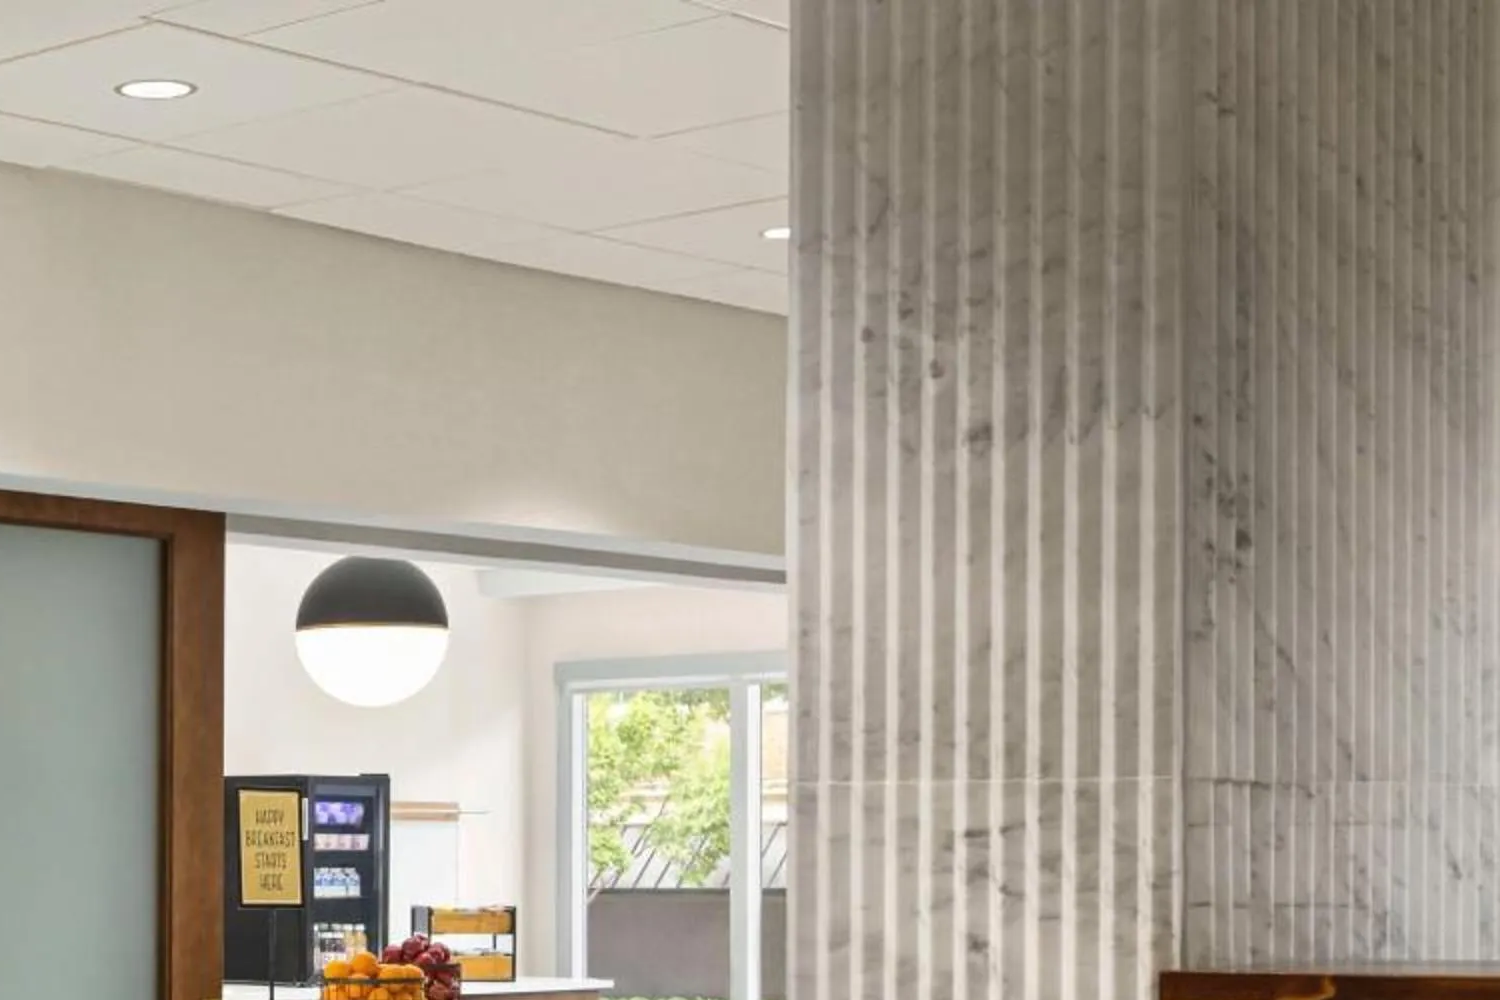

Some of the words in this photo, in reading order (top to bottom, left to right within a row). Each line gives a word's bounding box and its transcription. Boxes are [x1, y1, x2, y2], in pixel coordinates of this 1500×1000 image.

[255, 808, 284, 824] HAPPY
[245, 830, 295, 848] BREAKFAST
[255, 852, 287, 869] STARTS
[259, 873, 283, 891] HERE
